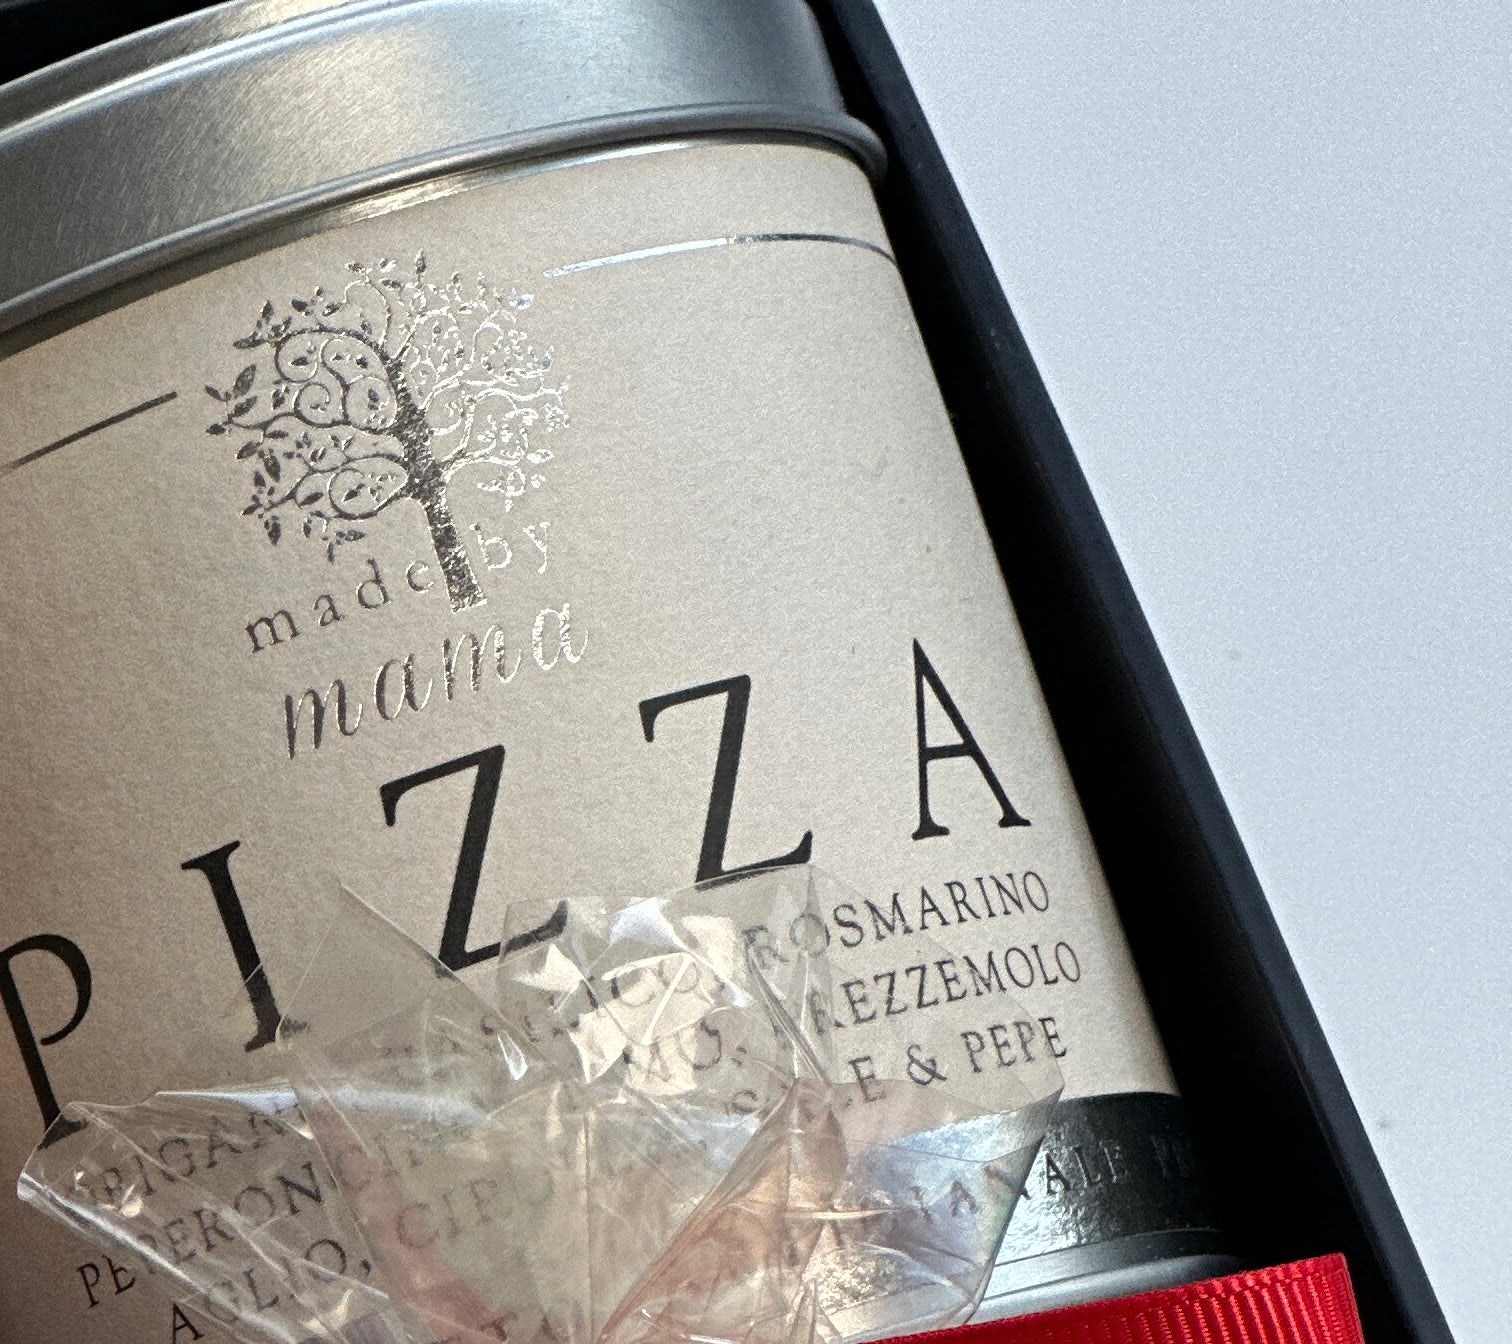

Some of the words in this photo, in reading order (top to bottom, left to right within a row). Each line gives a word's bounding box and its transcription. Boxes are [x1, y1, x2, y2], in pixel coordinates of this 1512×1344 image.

[243, 557, 436, 654] made
[469, 520, 552, 575] by
[284, 602, 589, 761] mama
[804, 939, 1083, 1037] REZZEMOLO
[906, 1043, 949, 1086] &
[960, 1015, 1069, 1074] PEPE
